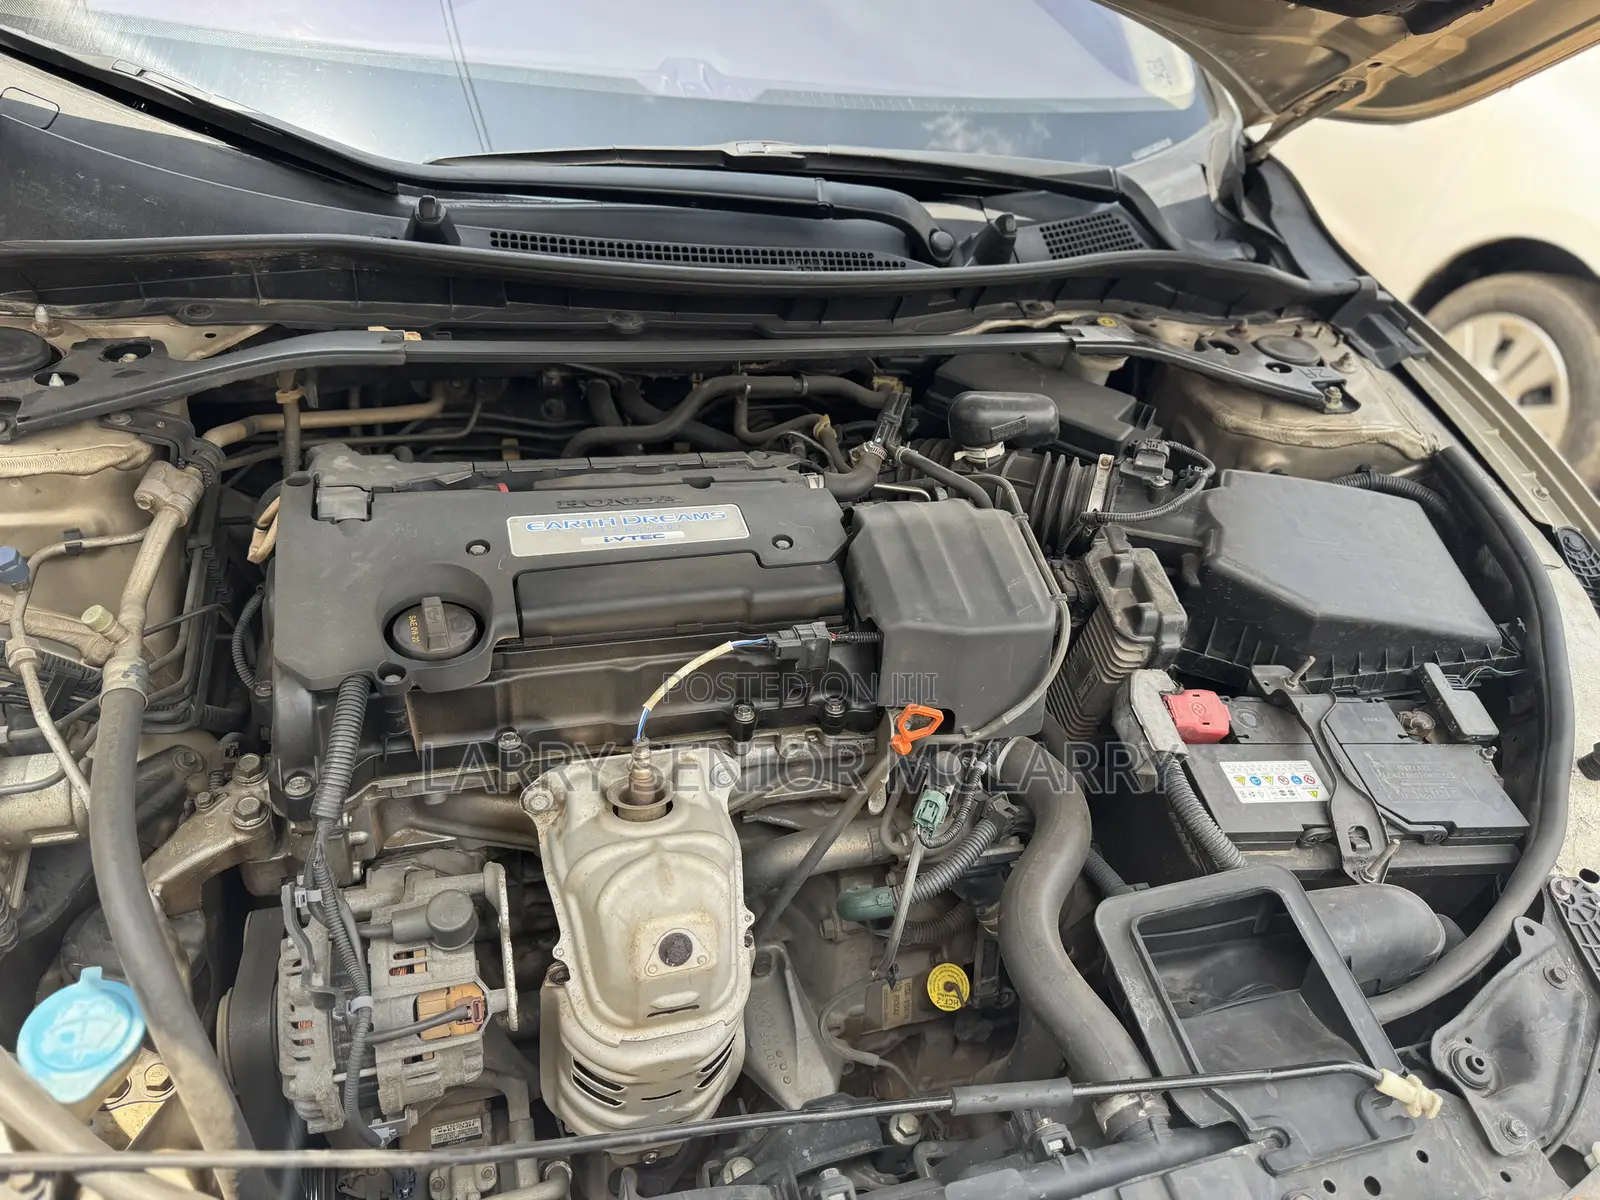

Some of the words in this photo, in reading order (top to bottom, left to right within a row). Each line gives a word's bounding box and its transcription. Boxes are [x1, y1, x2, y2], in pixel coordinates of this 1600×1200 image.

[556, 495, 685, 509] HONDA
[526, 516, 617, 532] EARTH
[621, 510, 728, 526] DREAMS
[603, 533, 666, 543] i-VTEC
